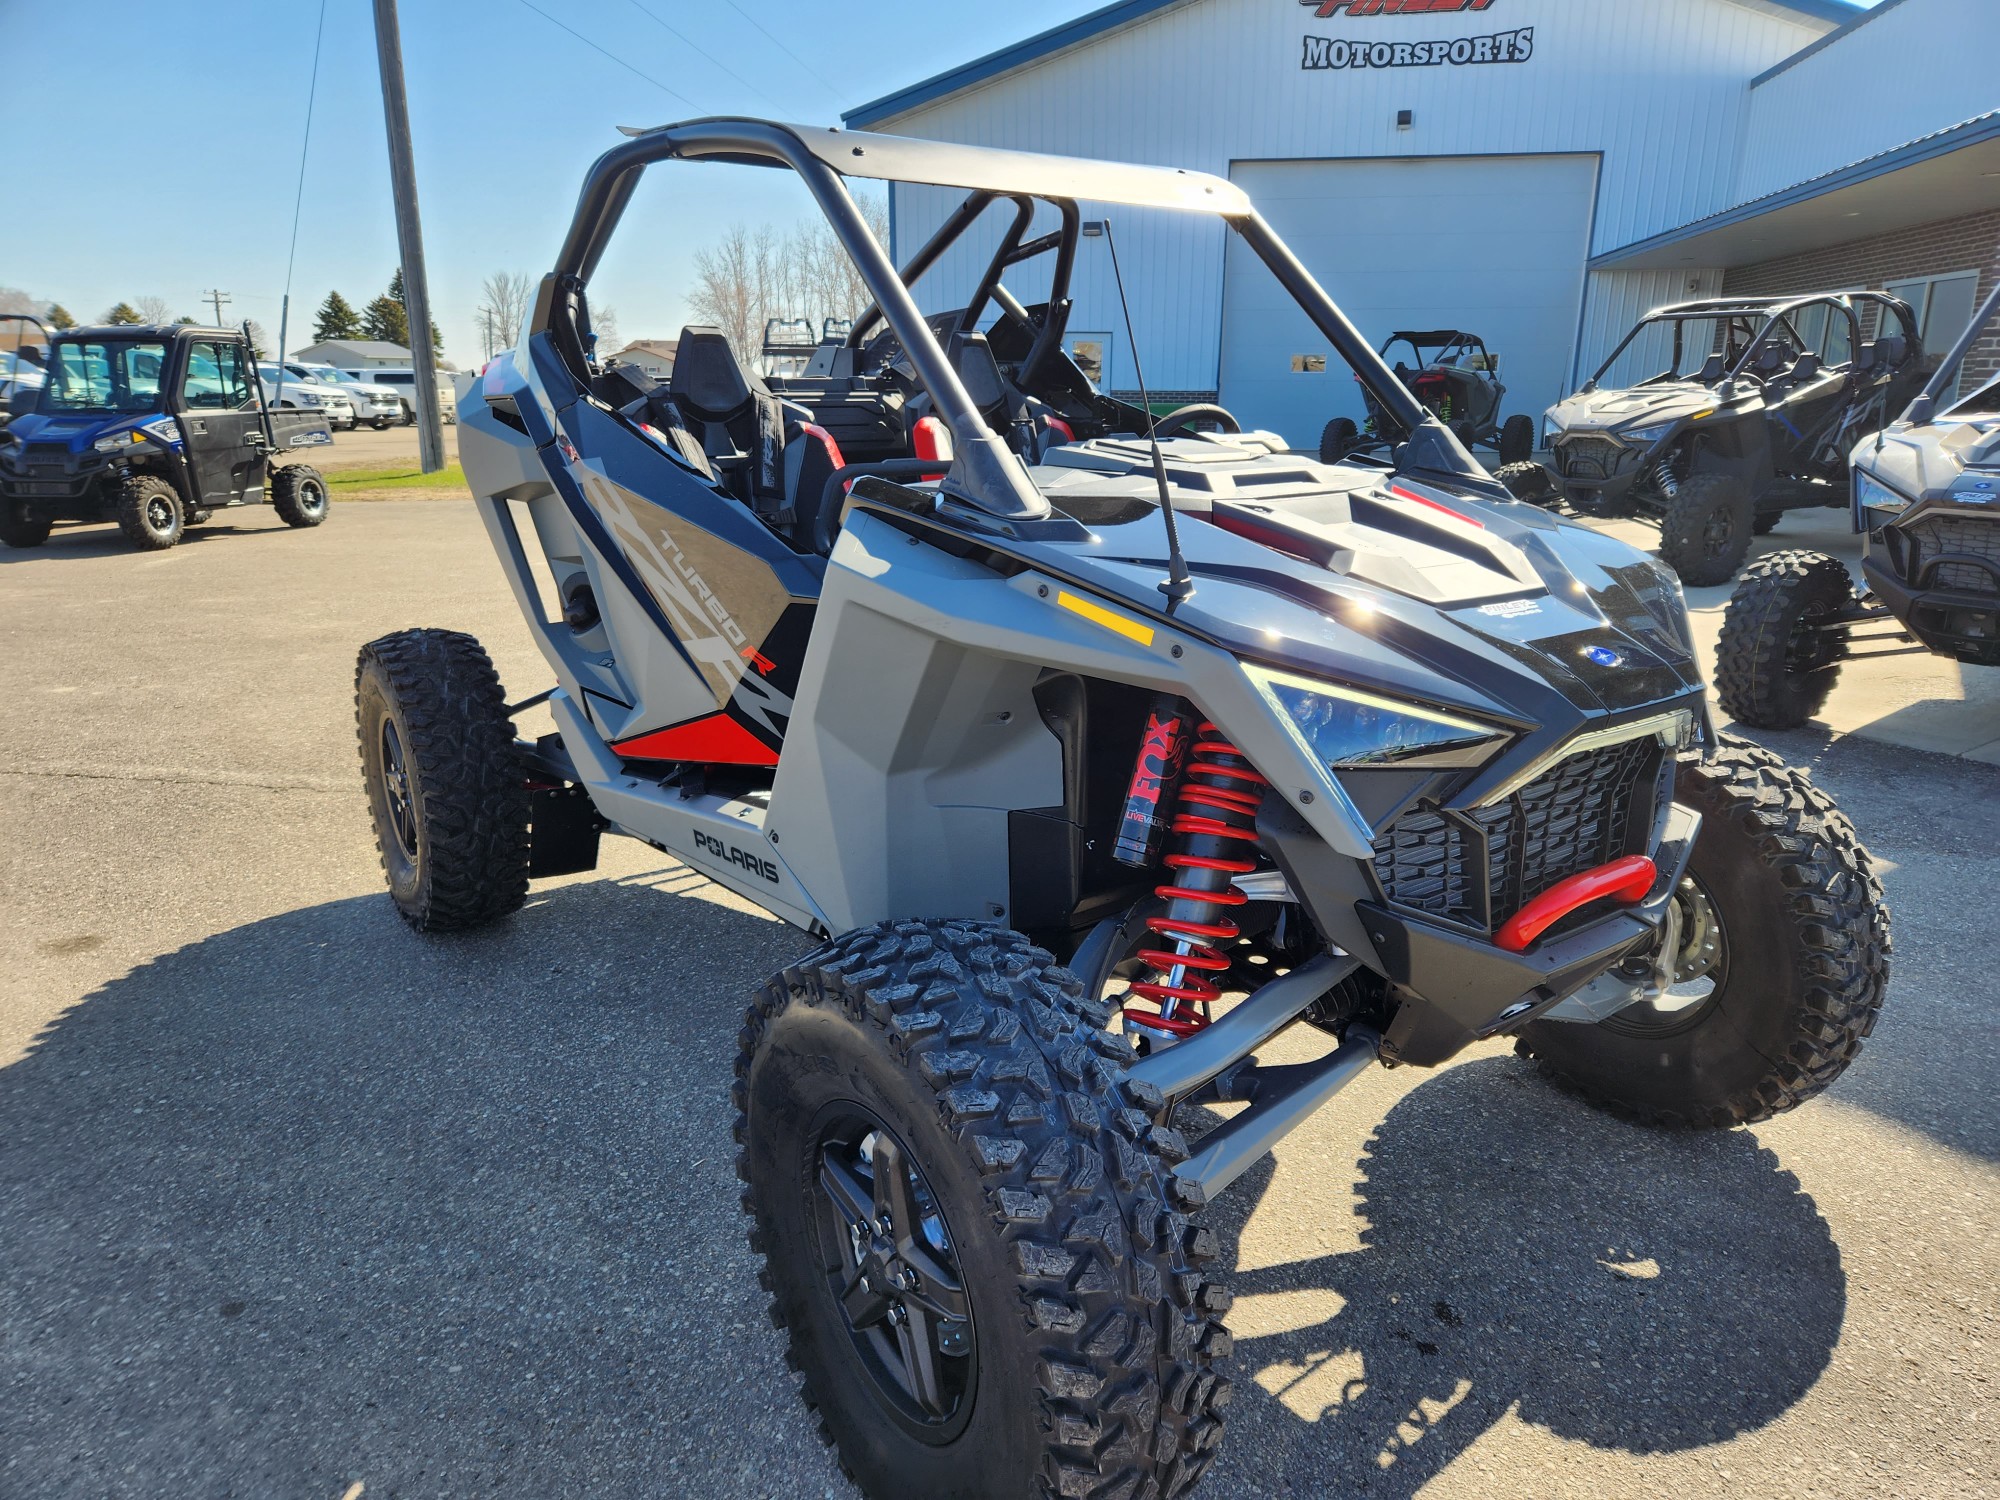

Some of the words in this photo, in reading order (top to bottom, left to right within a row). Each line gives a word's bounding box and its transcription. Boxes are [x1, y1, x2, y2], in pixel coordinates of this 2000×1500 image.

[1302, 26, 1534, 70] MOTORSPORTS
[660, 529, 747, 646] TURBO
[740, 645, 777, 677] R
[1129, 713, 1182, 804] FOX
[693, 829, 779, 883] POLARIS
